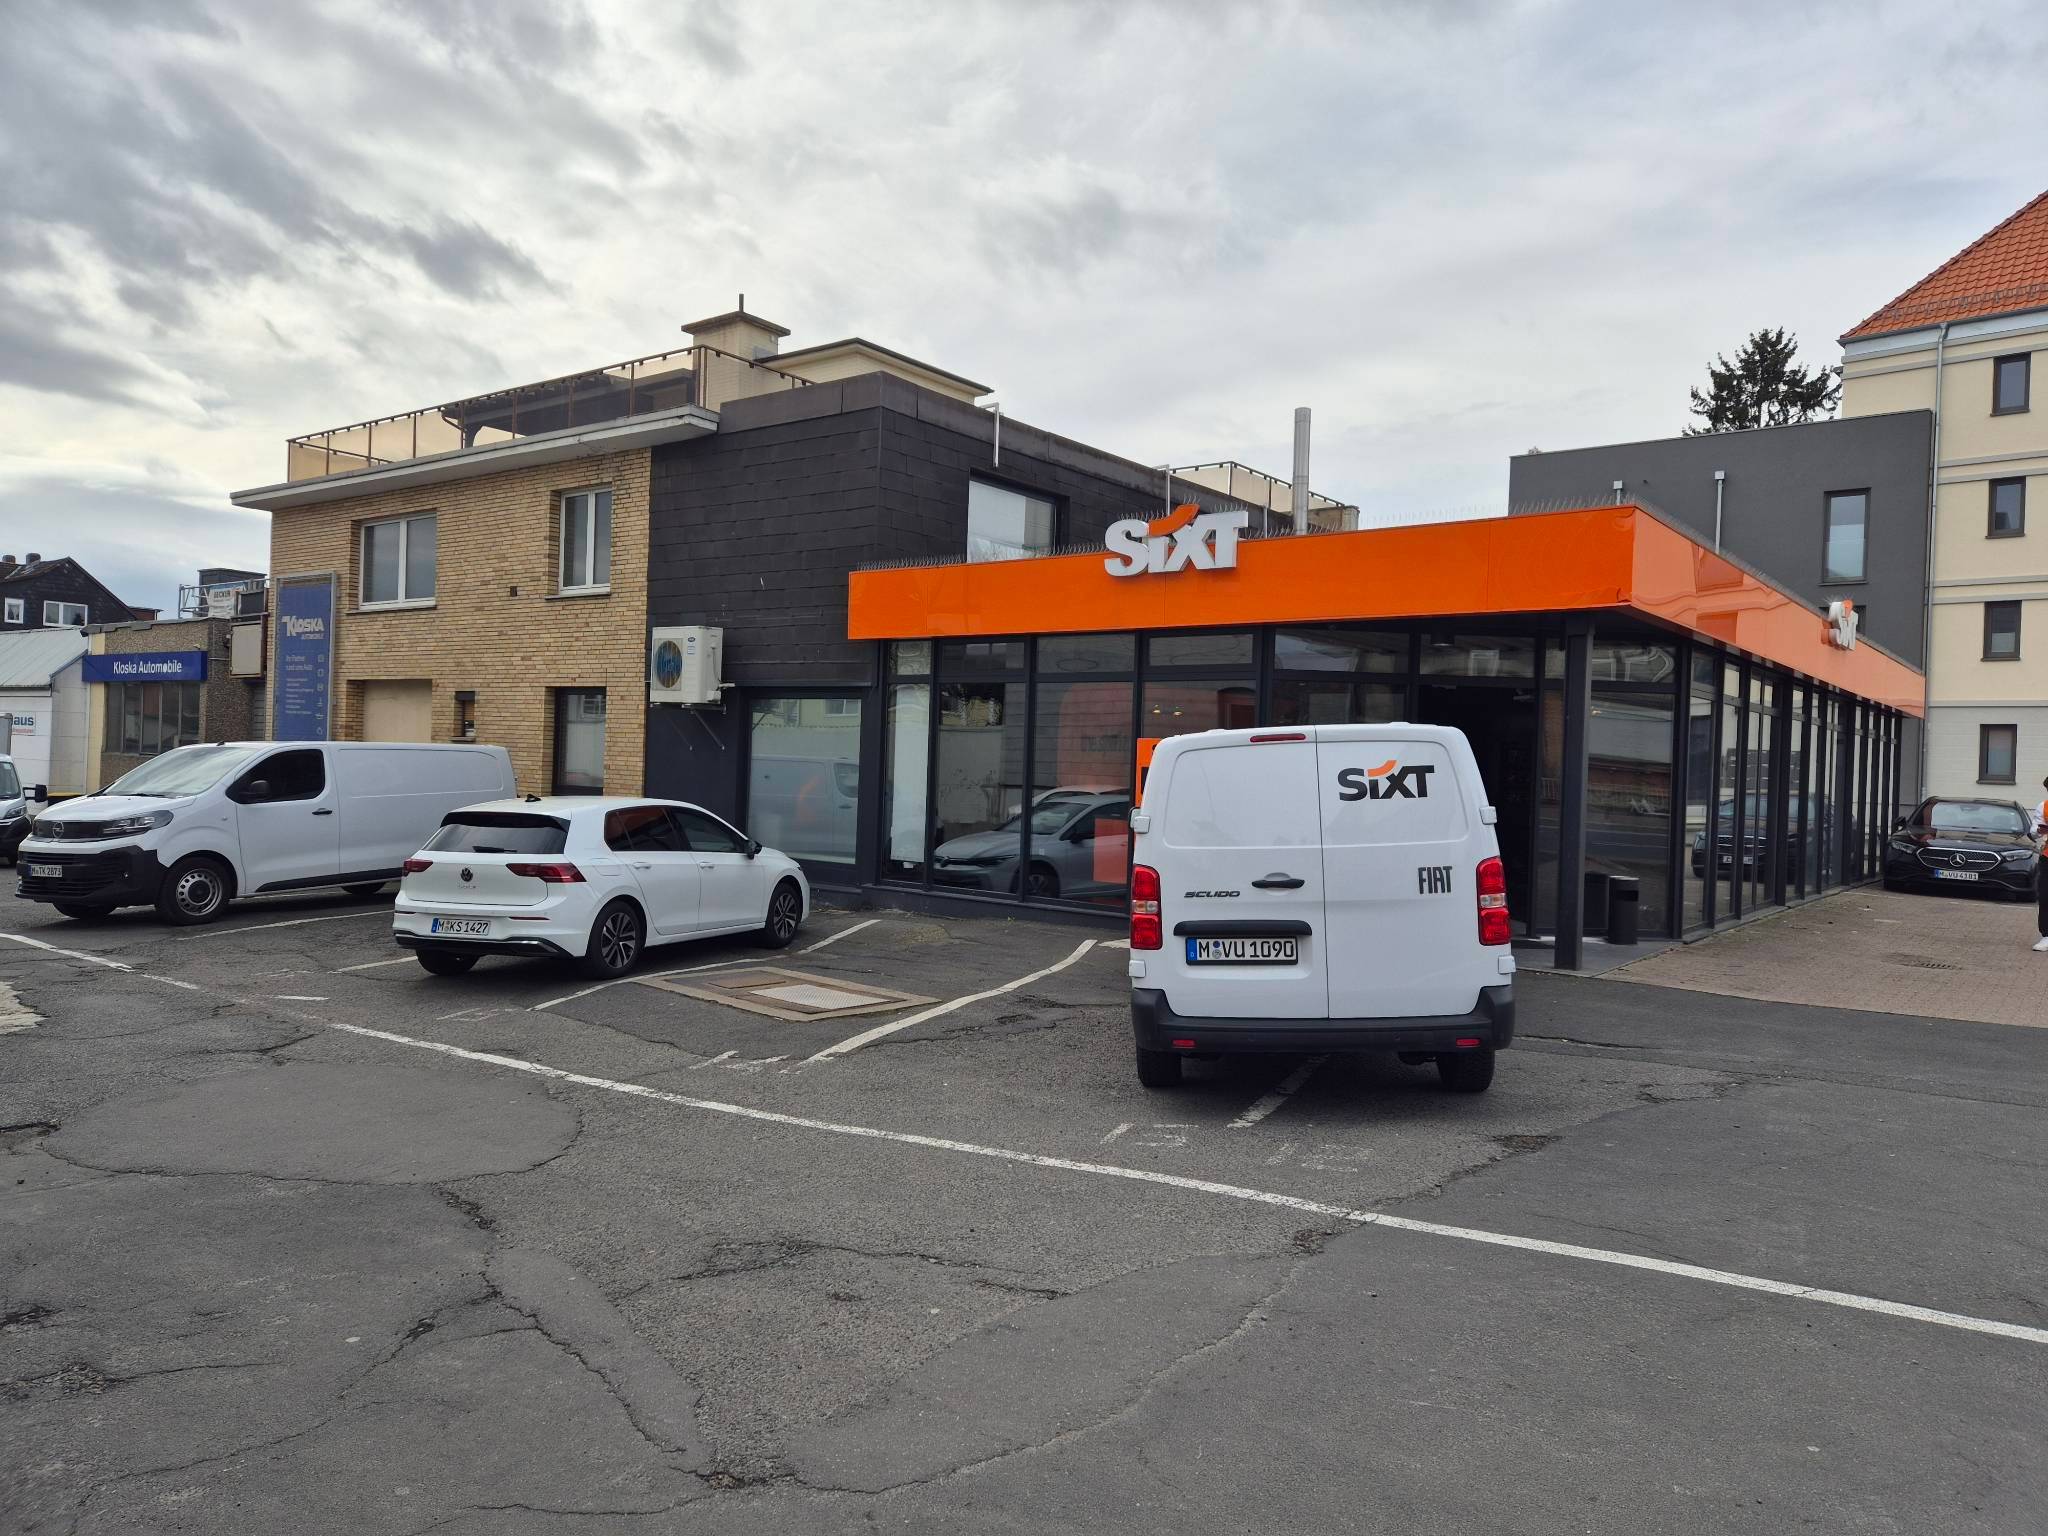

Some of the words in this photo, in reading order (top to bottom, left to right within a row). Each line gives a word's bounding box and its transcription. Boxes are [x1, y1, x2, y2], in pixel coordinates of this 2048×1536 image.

[113, 661, 137, 674] Kloska
[138, 659, 183, 674] Automobile
[1417, 865, 1453, 895] FIAT
[1184, 890, 1241, 898] SCUDO
